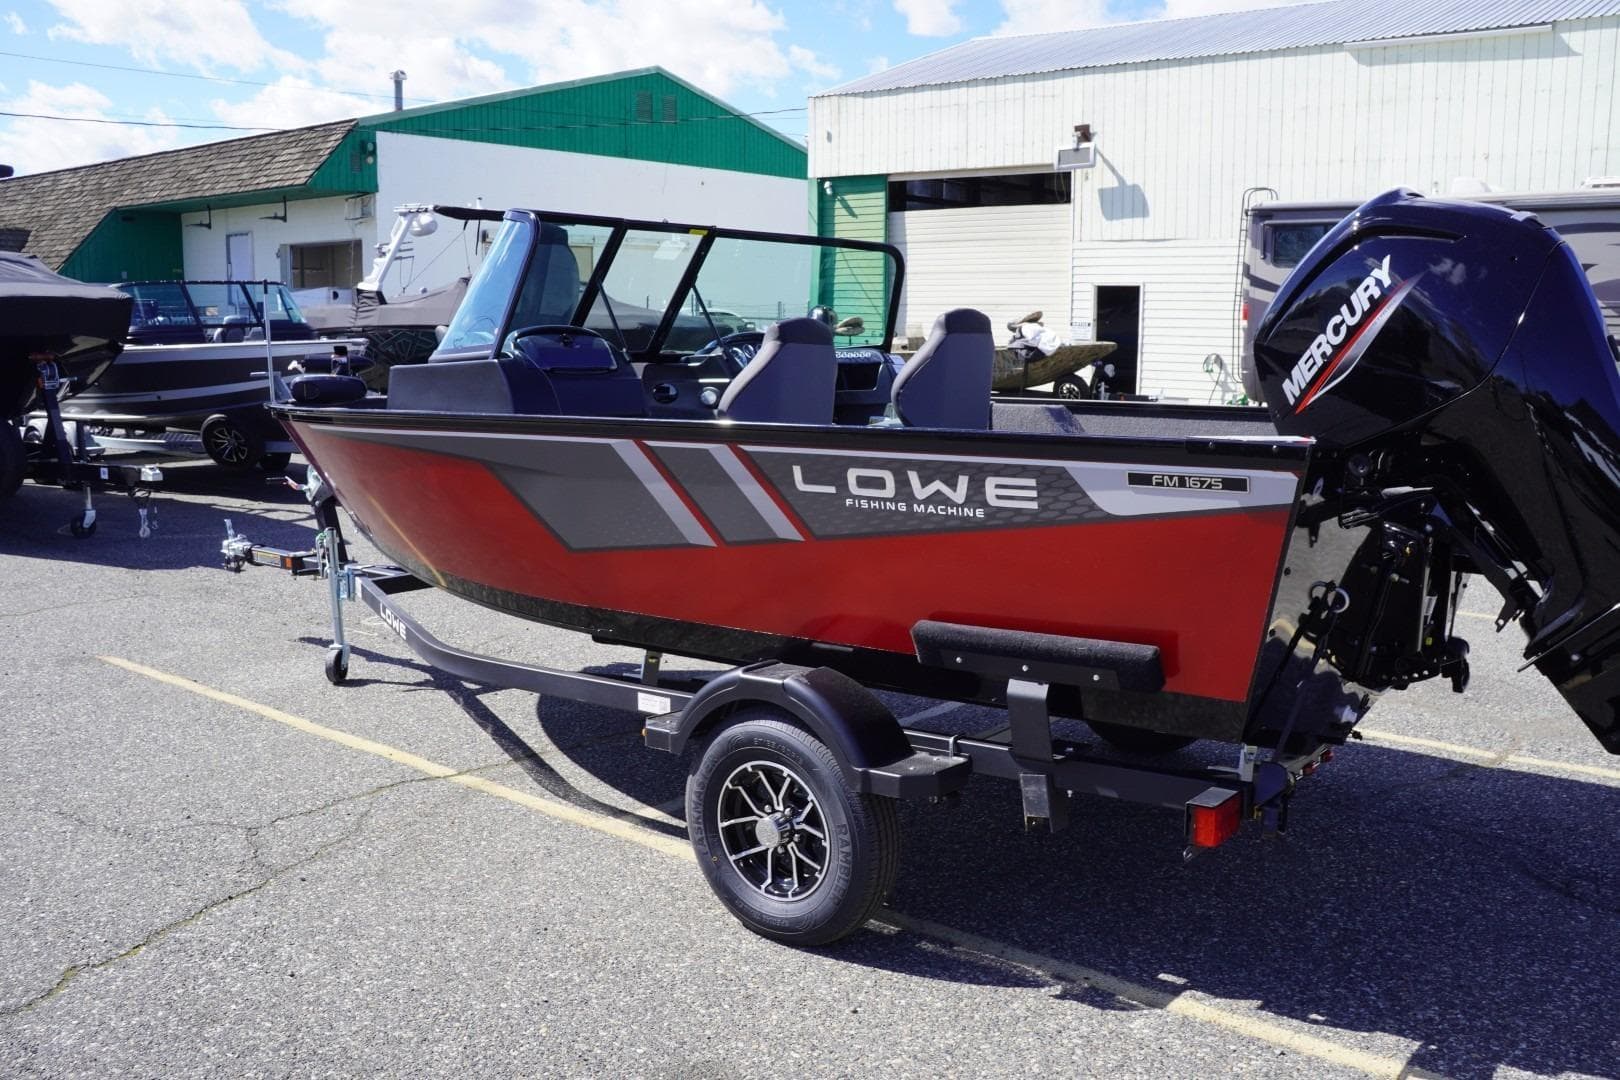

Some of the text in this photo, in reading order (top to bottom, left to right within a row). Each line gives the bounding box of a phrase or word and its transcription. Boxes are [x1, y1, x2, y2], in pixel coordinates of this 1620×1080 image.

[1281, 254, 1392, 406] MERCURY
[792, 464, 1039, 509] LOWE
[1151, 474, 1223, 490] FM 1675
[846, 499, 985, 518] FISHING MACHINE
[379, 600, 407, 641] LOWE
